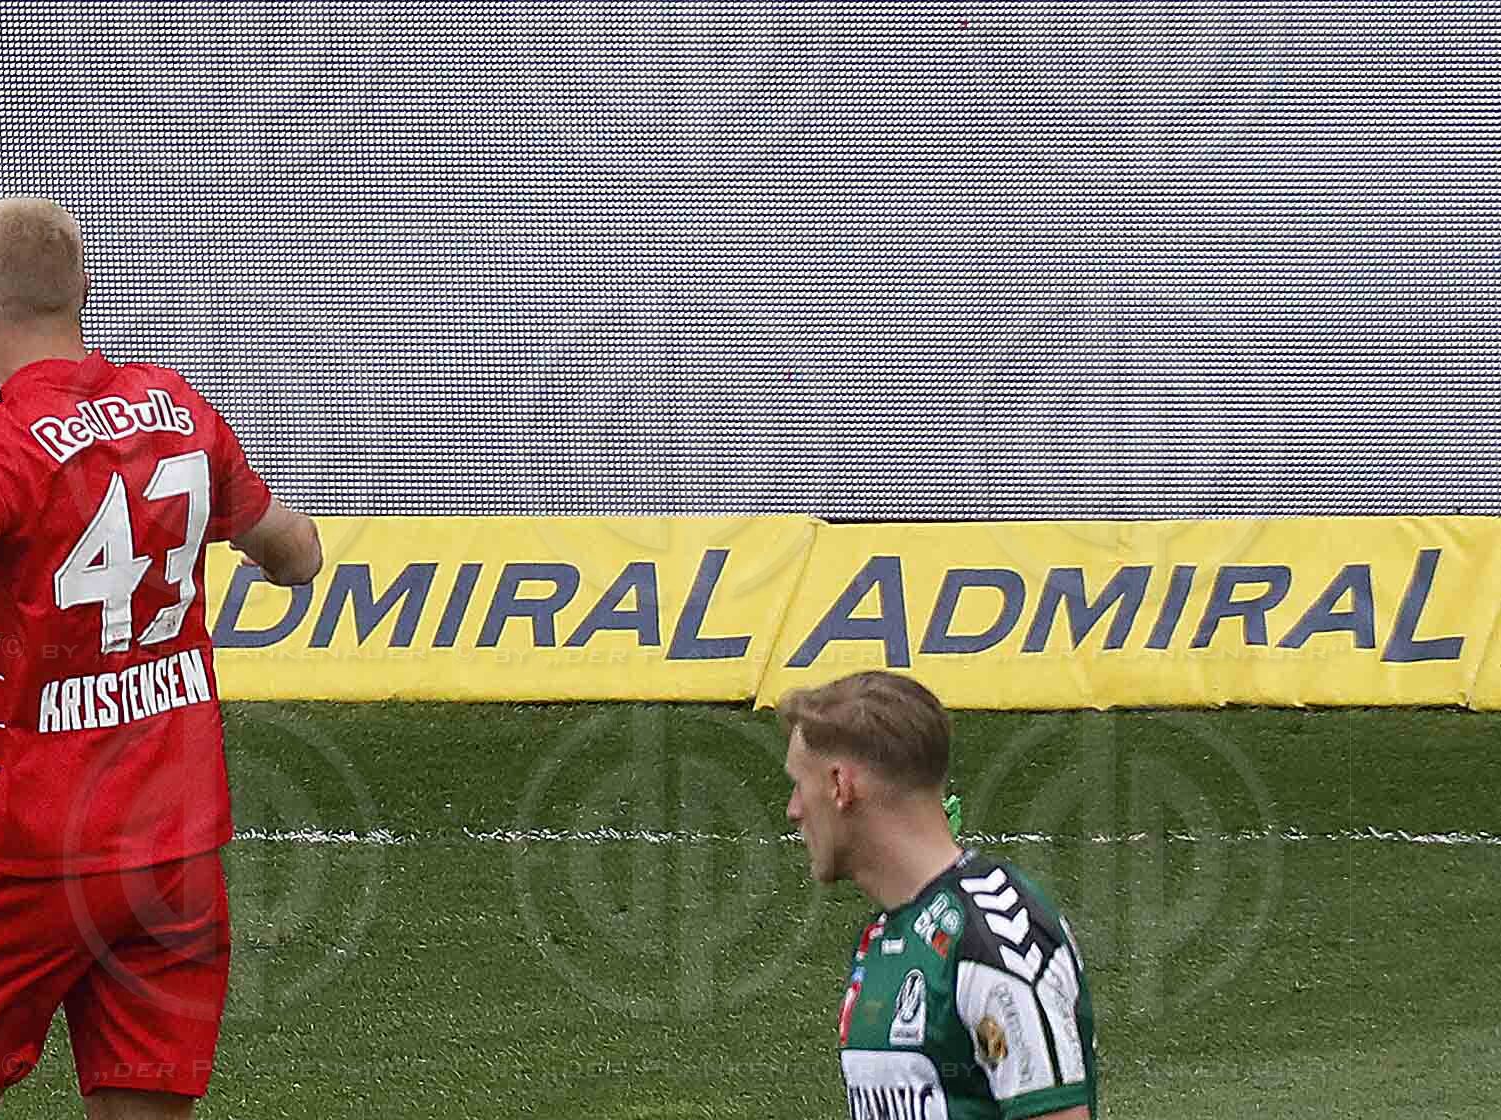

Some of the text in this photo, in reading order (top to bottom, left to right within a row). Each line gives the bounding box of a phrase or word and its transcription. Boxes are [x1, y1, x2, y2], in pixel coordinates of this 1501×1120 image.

[54, 450, 212, 654] 43
[212, 549, 751, 660] DMIRAL
[786, 548, 1466, 668] ADMIRAL
[39, 648, 212, 733] KRISTENSEN
